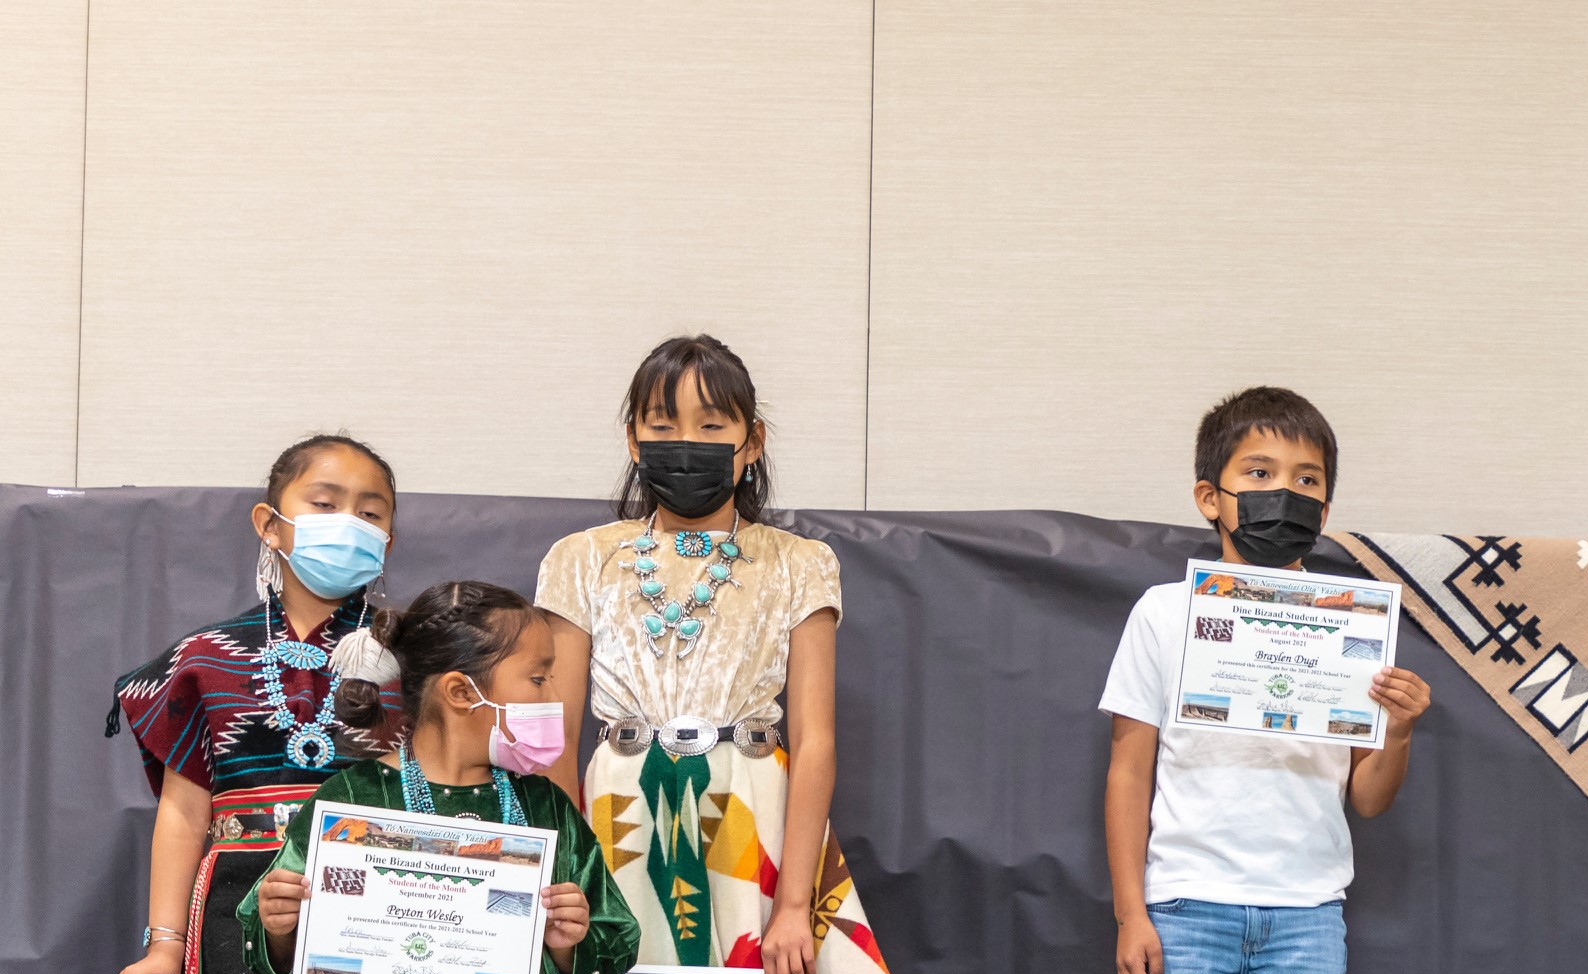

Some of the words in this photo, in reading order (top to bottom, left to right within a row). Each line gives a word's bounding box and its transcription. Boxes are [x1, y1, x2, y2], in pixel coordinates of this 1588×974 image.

[1232, 605, 1252, 615] Dine
[1254, 608, 1284, 619] Bizaad
[1286, 612, 1318, 622] Student
[1323, 616, 1349, 626] Award
[1254, 627, 1280, 635] Student
[1302, 632, 1324, 640] Month
[1292, 639, 1307, 647] 2021
[1255, 650, 1292, 665] Braylen
[1293, 655, 1319, 668] Dugi
[365, 854, 387, 865] Dine
[390, 857, 422, 869] Bizaad
[425, 861, 461, 873] Student
[464, 867, 496, 878] Award
[389, 878, 417, 888] Student
[428, 883, 441, 891] the
[442, 884, 467, 894] Month
[399, 890, 436, 899] September
[438, 893, 453, 902] 2021
[386, 905, 424, 921] Peyton
[426, 909, 464, 926] Wesley
[405, 931, 421, 944] TUBA
[422, 932, 436, 944] CITY
[406, 947, 434, 962] WARRIORS
